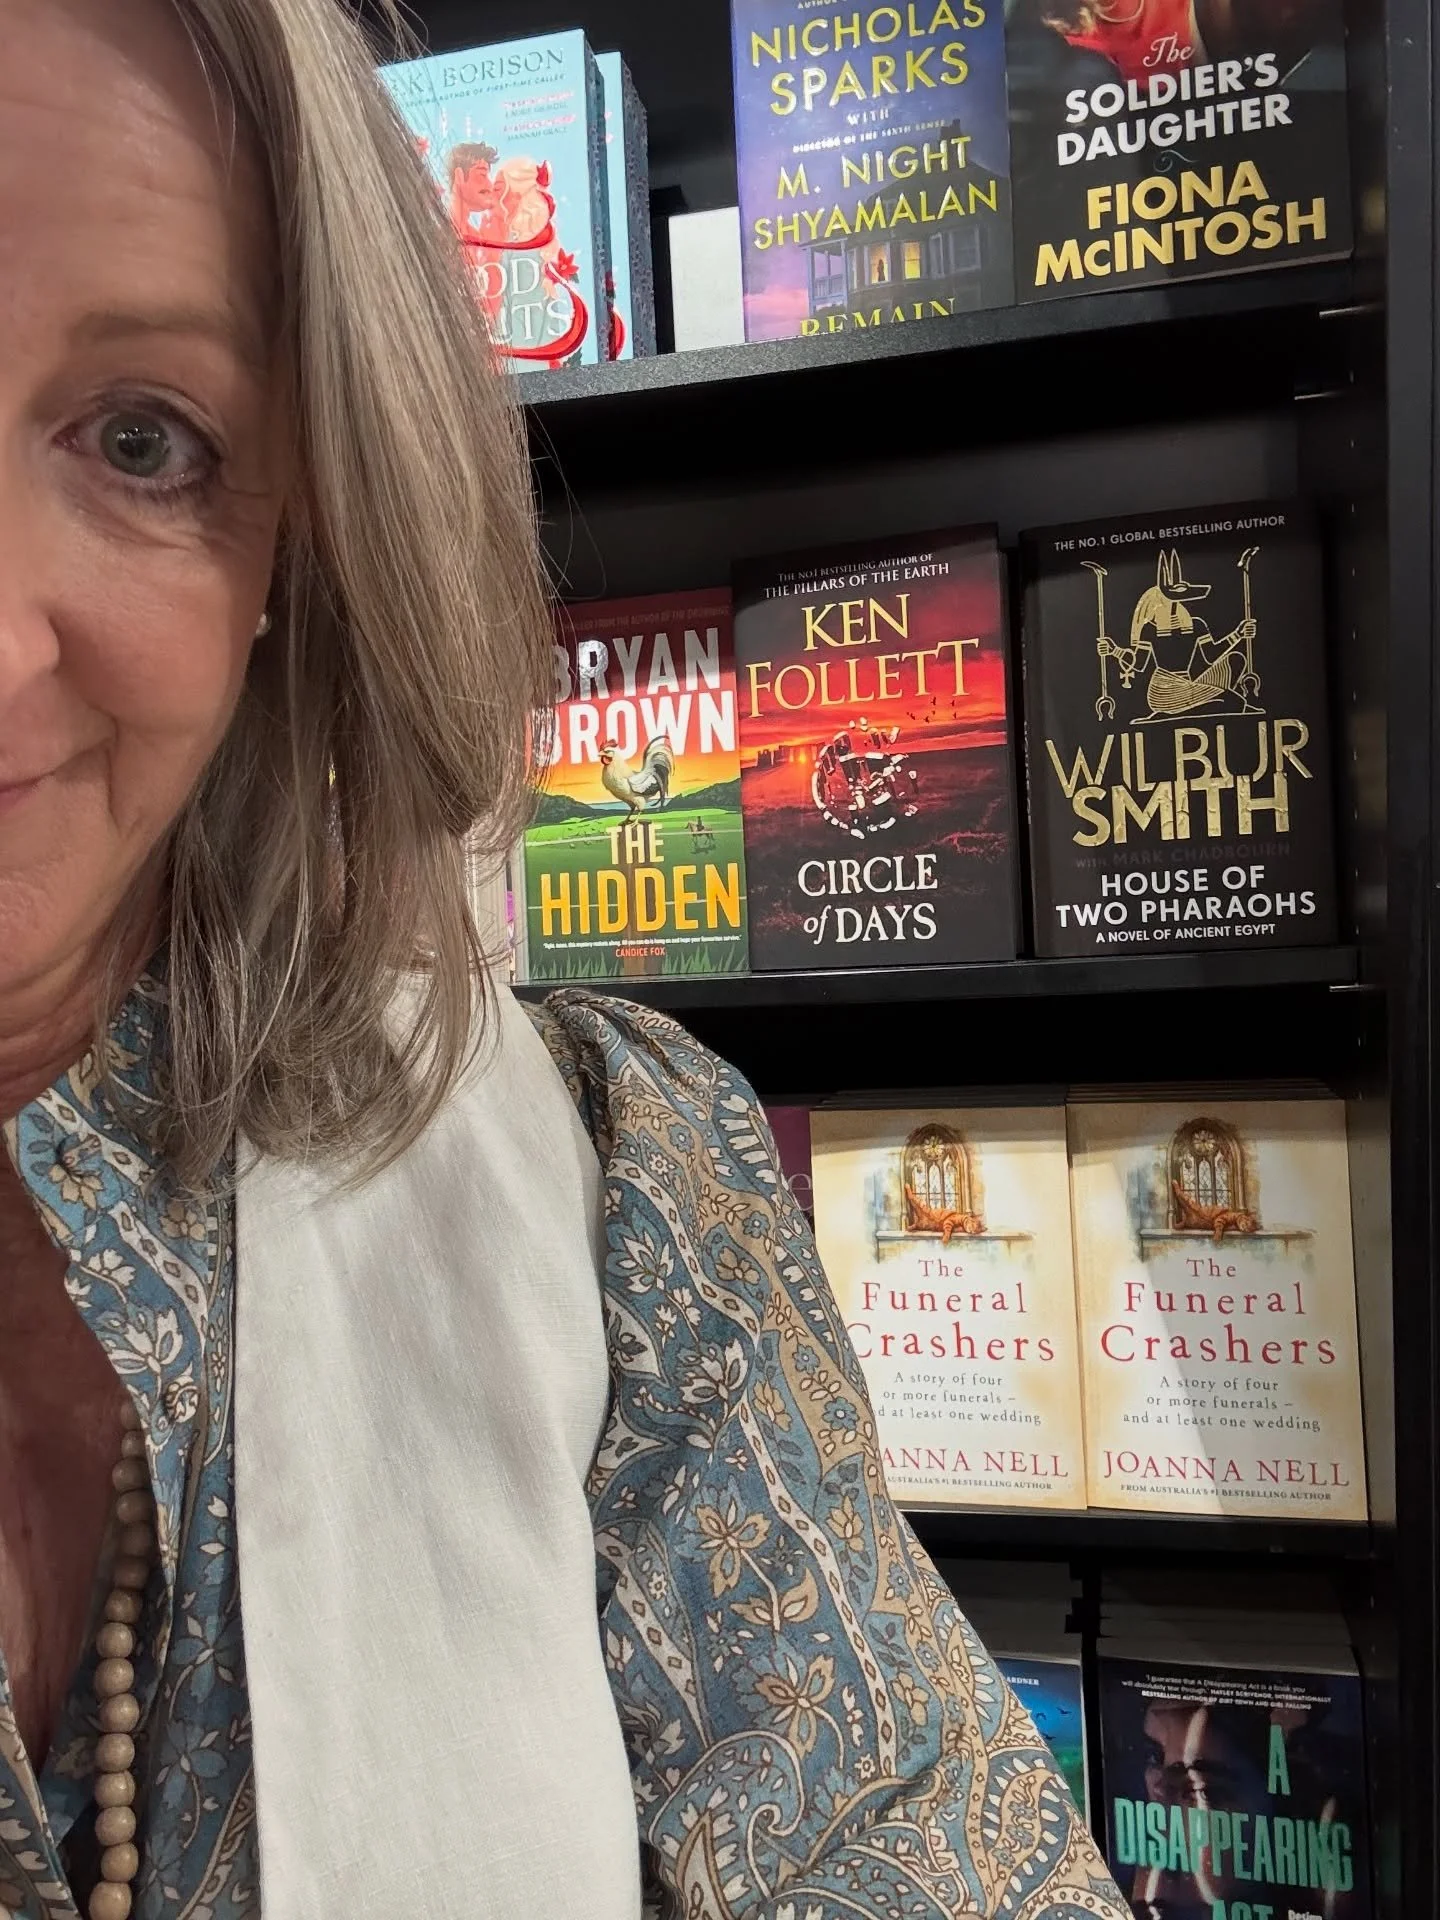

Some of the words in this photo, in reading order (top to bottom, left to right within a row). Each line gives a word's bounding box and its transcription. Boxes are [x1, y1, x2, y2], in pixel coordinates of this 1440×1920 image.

[751, 0, 986, 67] NICHOLAS
[1143, 32, 1196, 68] The
[443, 48, 564, 88] BORISON
[770, 42, 969, 116] SPARKS
[1065, 52, 1279, 124] SOLDIER'S
[846, 107, 889, 126] WITH
[1056, 93, 1293, 167] DAUGHTER
[777, 163, 821, 200] M.
[841, 136, 971, 189] NIGHT
[1087, 159, 1270, 230] FIONA
[754, 180, 998, 250] SHYAMALAN
[1054, 540, 1075, 551] THE
[1078, 537, 1105, 549] NO.1
[1110, 530, 1155, 545] GLOBAL
[1159, 521, 1233, 539] BESTSELLING
[1236, 515, 1286, 529] AUTHOR
[878, 555, 917, 568] AUTHOR
[919, 553, 934, 562] OF
[764, 585, 790, 598] THE
[794, 576, 845, 595] PILLARS
[849, 574, 868, 587] OF
[871, 569, 899, 584] THE
[904, 562, 950, 580] EARTH
[801, 593, 910, 651] KEN
[746, 638, 979, 718] FOLLETT
[1045, 719, 1313, 799] WILBUR
[1072, 771, 1289, 847] SMITH
[606, 823, 664, 865] THE
[798, 853, 938, 897] CIRCLE
[1101, 868, 1208, 897] HOUSE
[1222, 865, 1265, 890] OF
[541, 863, 741, 936] HIDDEN
[1056, 902, 1128, 928] TWO
[1141, 891, 1316, 923] PHARAOHS
[803, 905, 831, 945] of
[835, 903, 937, 943] DAYS
[1095, 932, 1106, 943] A
[1108, 930, 1150, 943] NOVEL
[1153, 928, 1172, 940] OF
[1175, 926, 1231, 939] ANCIENT
[1235, 923, 1276, 936] EGYPT
[616, 947, 648, 957] CANDICE
[650, 947, 666, 956] FOX
[918, 1259, 963, 1277] The
[1186, 1258, 1237, 1278] The
[861, 1281, 1028, 1313] Funeral
[1124, 1281, 1306, 1315] Funeral
[1100, 1323, 1336, 1364] Crashers
[883, 1391, 896, 1400] or
[902, 1392, 937, 1402] more
[943, 1390, 1002, 1404] funerals
[894, 1372, 903, 1383] A
[910, 1374, 945, 1387] story
[952, 1373, 966, 1384] of
[972, 1374, 1003, 1386] four
[1159, 1376, 1170, 1388] A
[1177, 1378, 1216, 1392] story
[1223, 1377, 1240, 1389] of
[1245, 1378, 1278, 1391] four
[892, 1408, 903, 1417] at
[911, 1408, 942, 1419] least
[949, 1412, 973, 1421] one
[981, 1411, 1042, 1425] wedding
[1147, 1396, 1160, 1405] or
[1169, 1397, 1206, 1408] more
[1213, 1396, 1278, 1410] funerals
[1123, 1411, 1149, 1424] and
[1156, 1413, 1169, 1424] at
[1177, 1413, 1213, 1427] least
[1220, 1417, 1246, 1428] one
[1254, 1416, 1321, 1432] wedding
[882, 1448, 972, 1472] ANNA
[984, 1450, 1069, 1478] NELL
[1103, 1450, 1243, 1482] JOANNA
[1256, 1459, 1350, 1487] NELL
[952, 1478, 1012, 1488] BESTSELLING
[1013, 1481, 1052, 1490] AUTHOR
[1121, 1484, 1147, 1493] FROM
[1222, 1489, 1287, 1499] BESTSELLING
[1289, 1491, 1331, 1500] AUTHOR
[1006, 1676, 1040, 1686] ARDNER
[1267, 1724, 1292, 1796] A
[1113, 1797, 1354, 1892] DISAPPEARING
